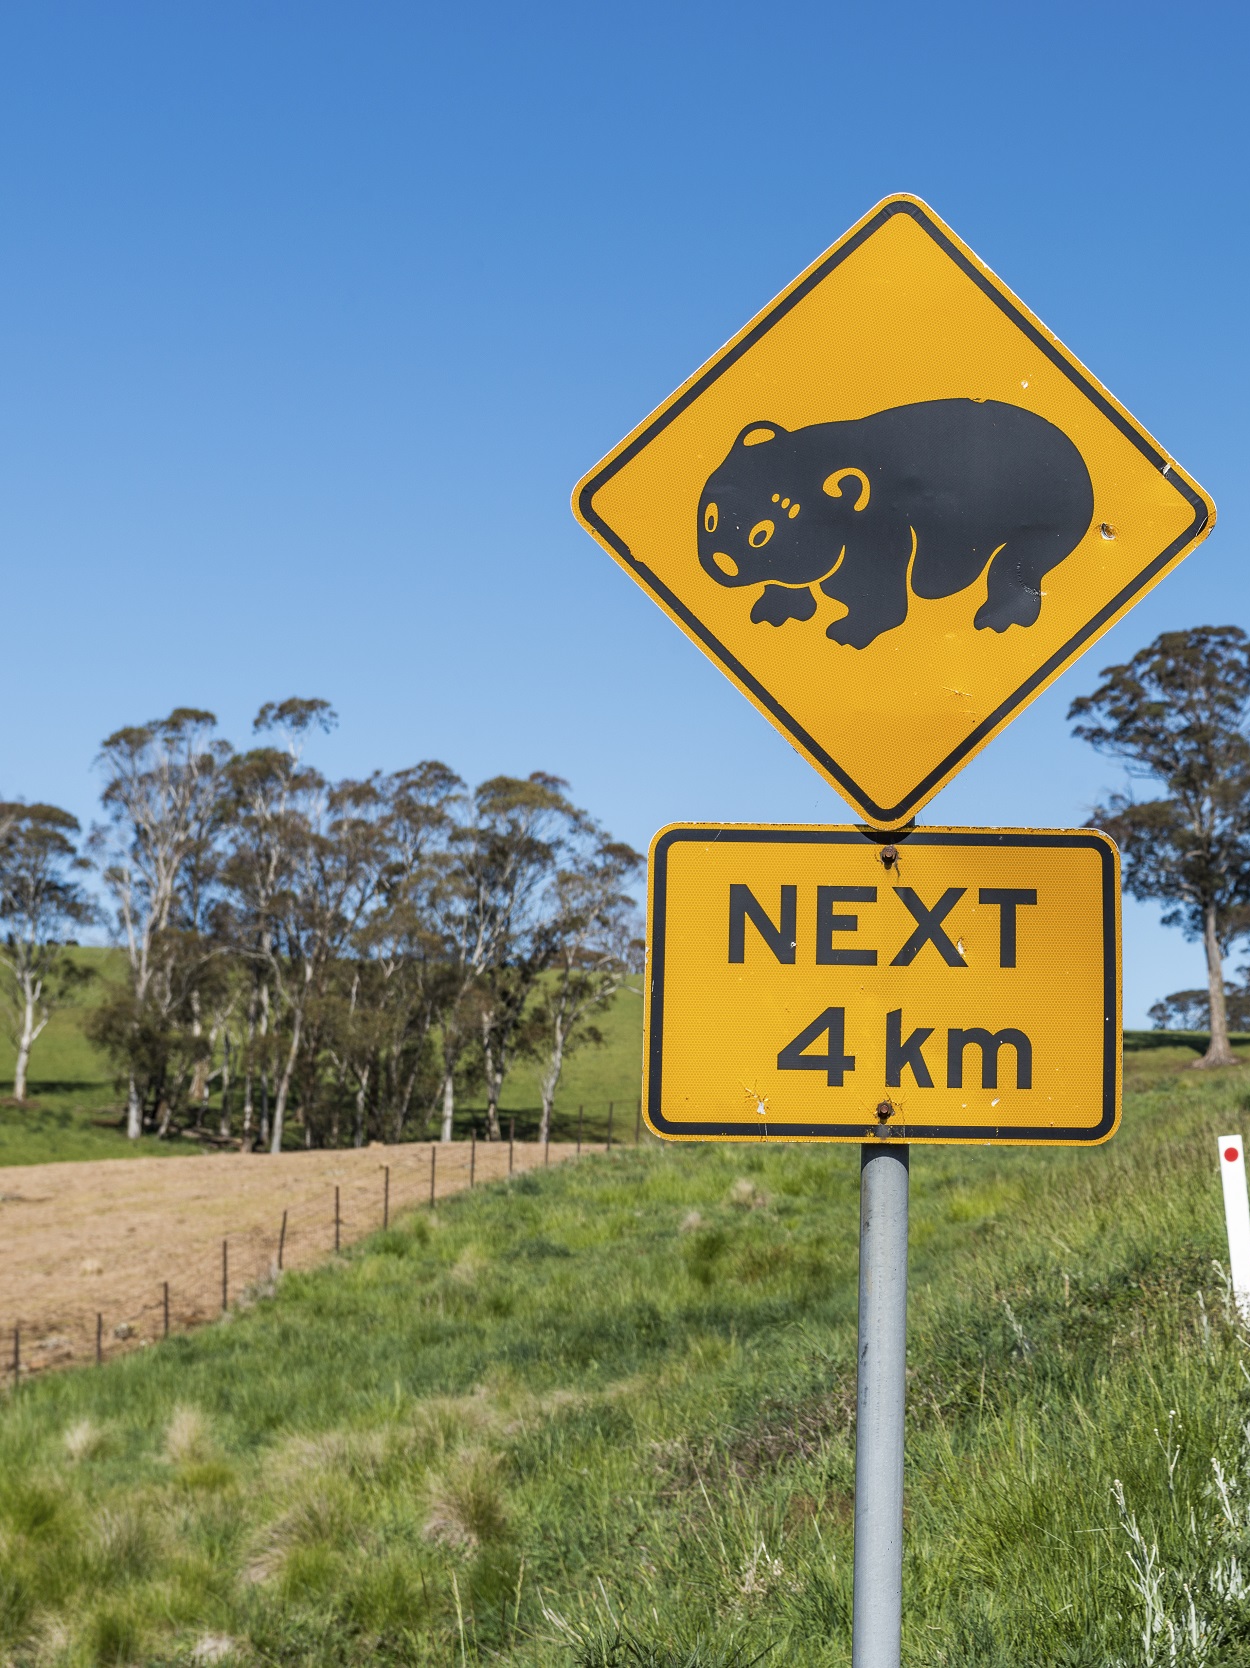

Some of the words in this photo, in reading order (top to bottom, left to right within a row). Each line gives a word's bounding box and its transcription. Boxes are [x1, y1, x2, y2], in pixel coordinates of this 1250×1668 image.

[728, 884, 1038, 968] NEXT
[777, 1007, 856, 1088] 4
[885, 1008, 1033, 1090] km
